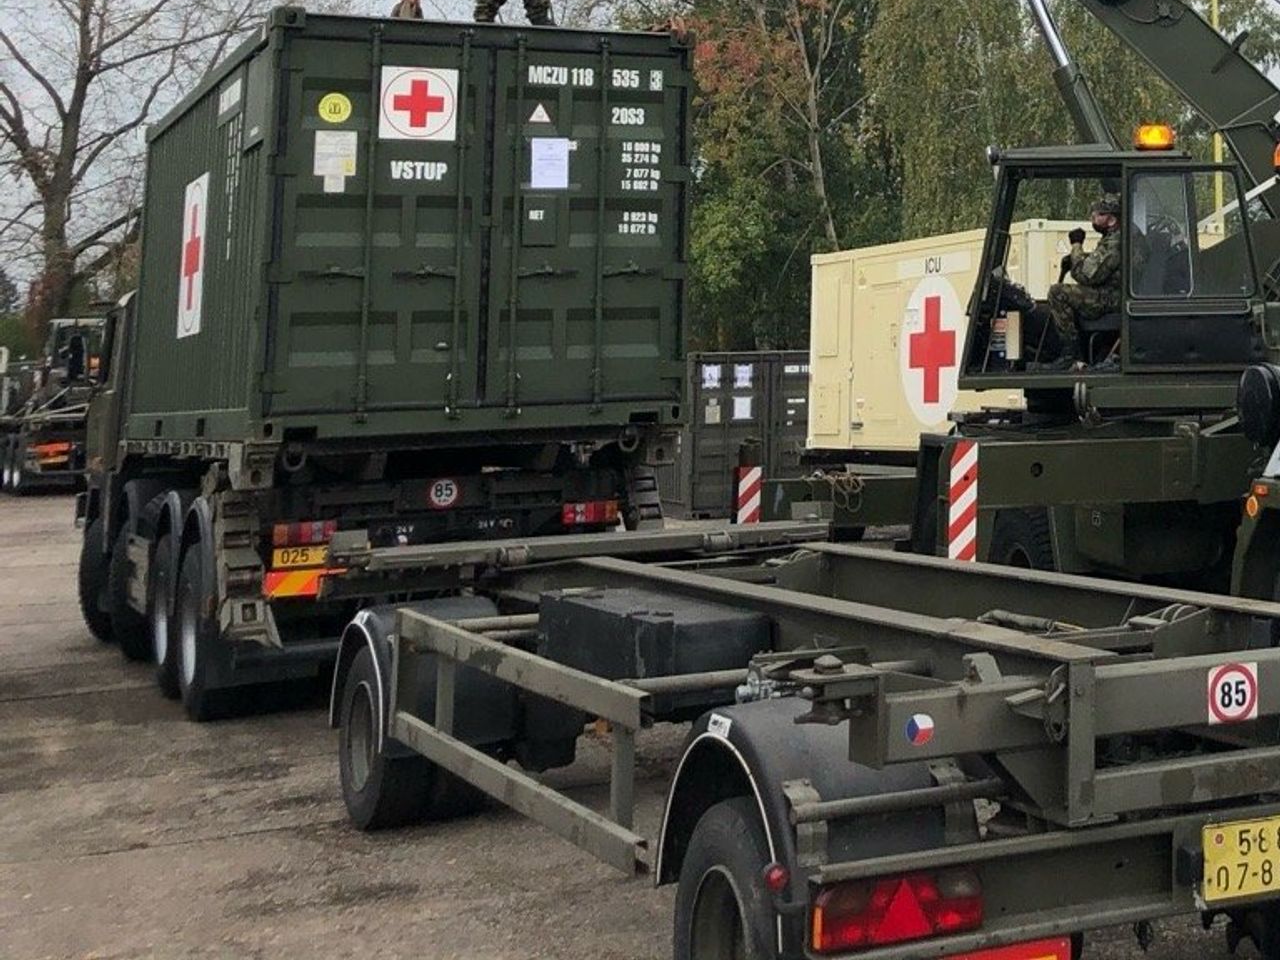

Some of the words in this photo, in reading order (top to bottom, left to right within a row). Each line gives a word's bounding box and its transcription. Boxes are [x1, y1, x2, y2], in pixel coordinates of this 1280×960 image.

[528, 65, 568, 86] MCZU
[571, 67, 594, 87] 118
[612, 68, 640, 88] 535
[611, 106, 645, 126] 20S3
[390, 160, 448, 181] VSTUP
[925, 256, 941, 274] ICU
[434, 483, 453, 498] 85
[281, 548, 309, 565] 025
[1220, 680, 1246, 708] 85
